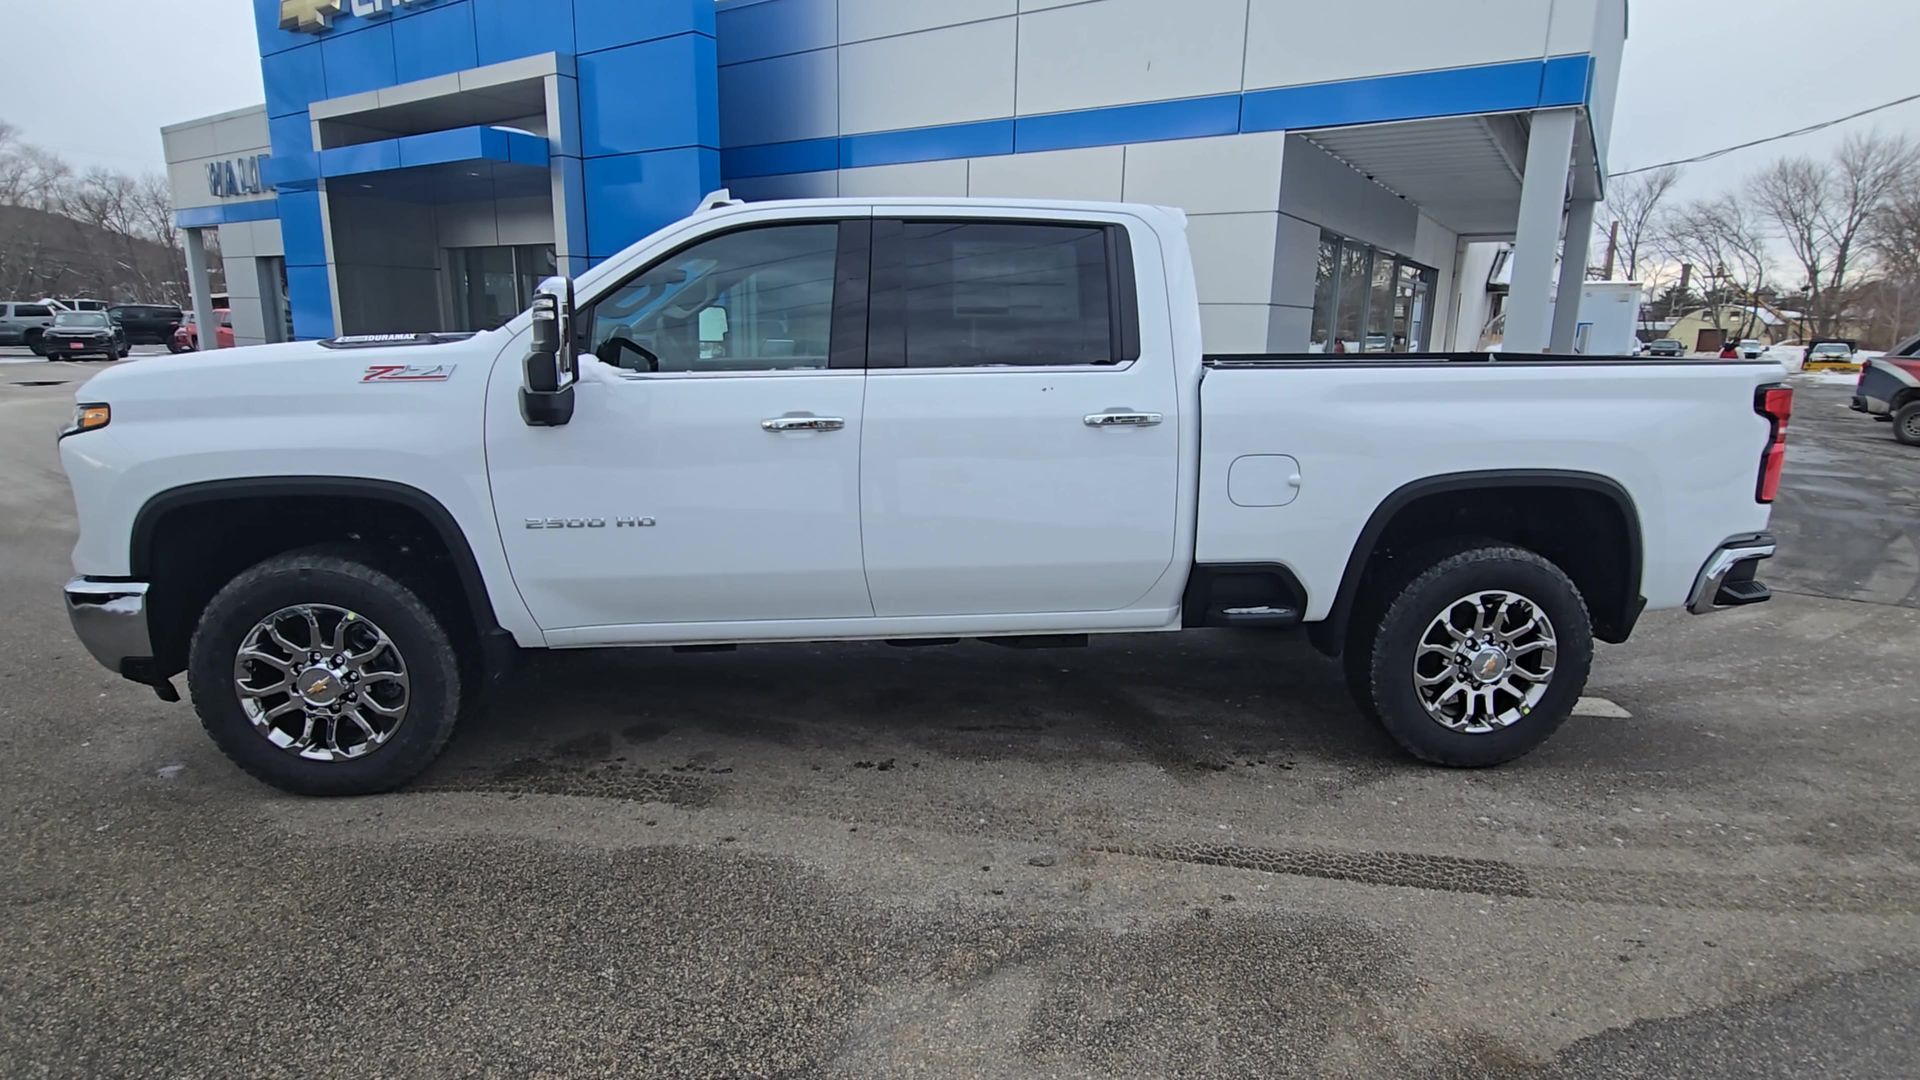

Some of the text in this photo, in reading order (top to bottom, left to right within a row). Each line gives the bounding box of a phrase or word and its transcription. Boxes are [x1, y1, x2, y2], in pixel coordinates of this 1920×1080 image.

[366, 333, 416, 342] DURAMAX
[524, 515, 656, 530] 2500 HD
